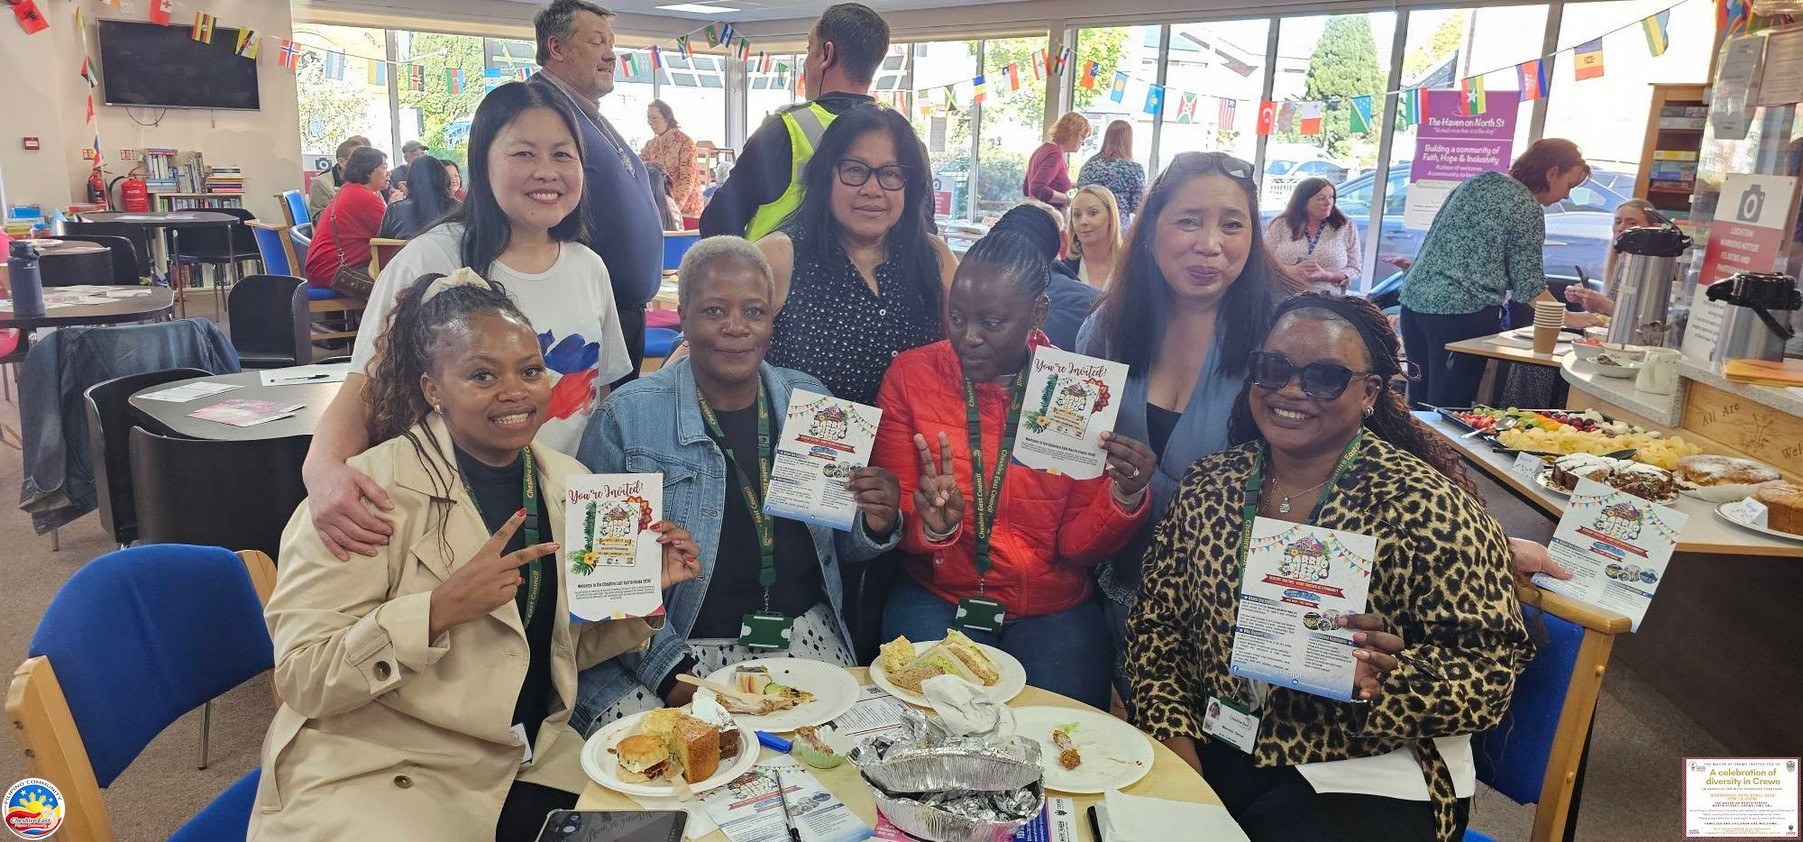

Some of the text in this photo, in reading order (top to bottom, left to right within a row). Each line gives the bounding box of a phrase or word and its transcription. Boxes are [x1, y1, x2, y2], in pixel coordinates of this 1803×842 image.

[1428, 117, 1442, 126] The
[1442, 118, 1464, 126] Haven
[1475, 118, 1495, 127] North
[1496, 118, 1504, 128] St
[1423, 154, 1440, 162] Faith,
[1440, 154, 1458, 164] Hope
[1466, 155, 1500, 165] Inclusivity
[1424, 144, 1450, 153] Building
[1456, 146, 1491, 154] community
[1731, 226, 1754, 238] LOCATION
[1742, 242, 1760, 252] NOTICE
[1034, 358, 1108, 378] You're Invited!
[1702, 402, 1740, 426] All Are
[1344, 446, 1357, 460] East
[760, 457, 768, 480] Cheshire
[526, 470, 534, 498] Cheshire
[568, 480, 644, 504] You're Invited!
[986, 449, 1008, 514] Cheshire East Council
[744, 486, 758, 512] Council
[978, 512, 986, 539] Cheshire
[1282, 554, 1328, 570] BARRIO
[530, 570, 541, 604] Council
